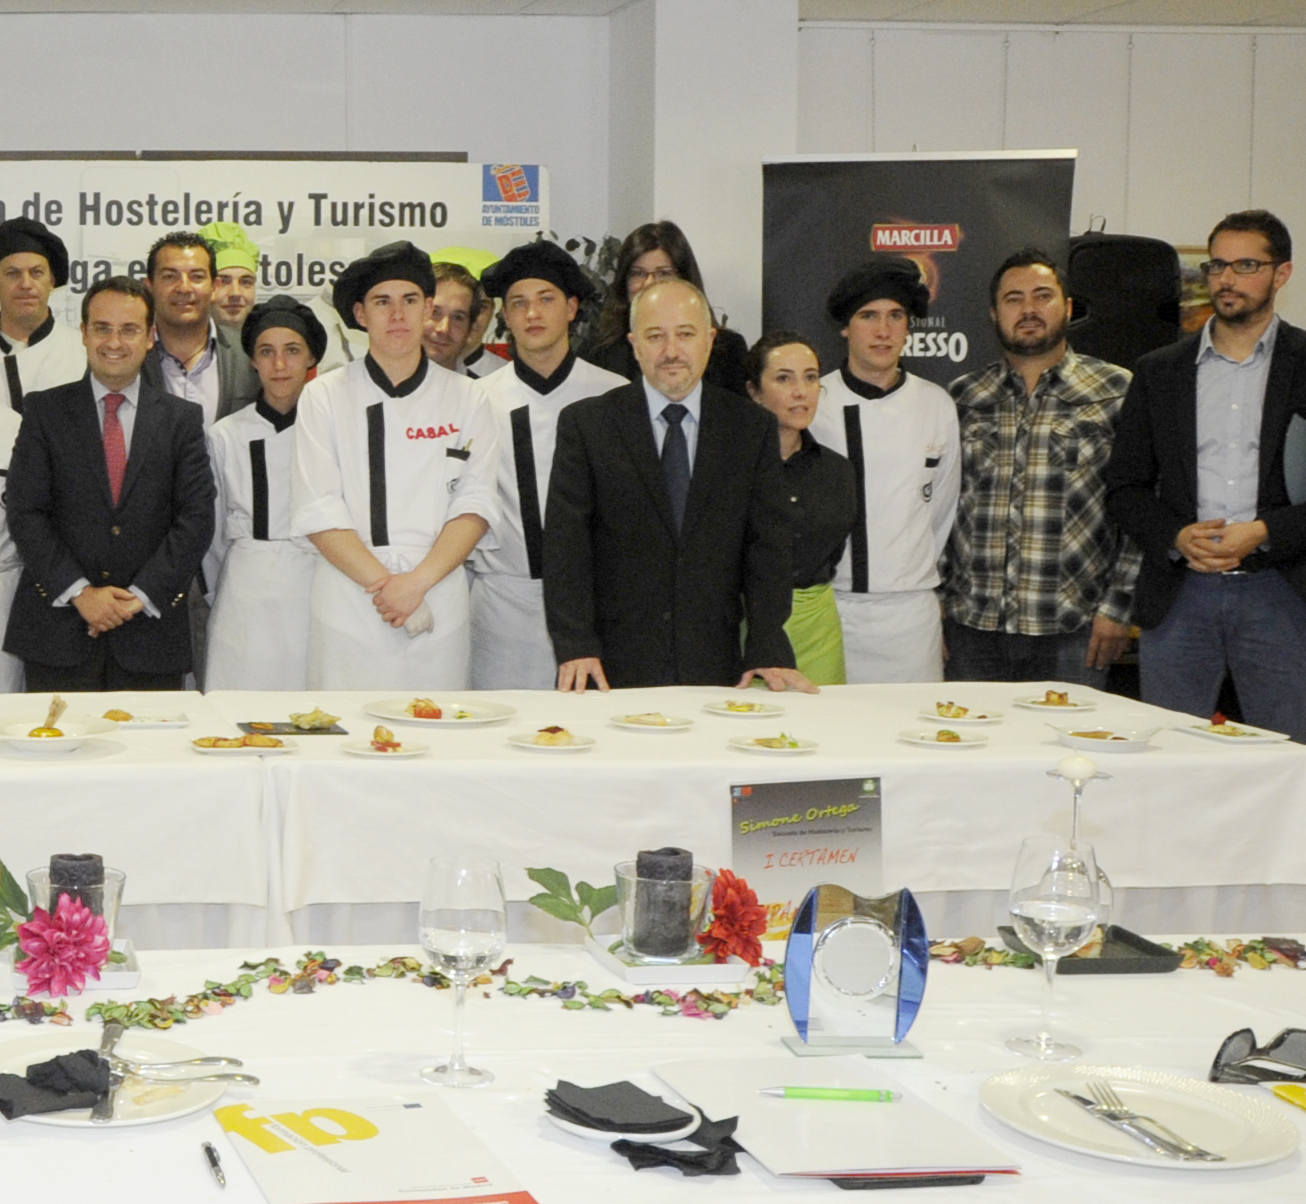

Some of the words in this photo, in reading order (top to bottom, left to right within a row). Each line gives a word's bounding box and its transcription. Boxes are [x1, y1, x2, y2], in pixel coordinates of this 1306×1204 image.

[22, 193, 63, 227] de
[79, 191, 263, 227] Hostelería
[278, 200, 295, 233] y
[308, 193, 448, 228] Turismo
[481, 204, 540, 214] AYUNTAMIENTO
[482, 216, 493, 226] DE
[876, 229, 953, 246] MARCILLA
[259, 253, 344, 288] toles
[909, 315, 945, 328] SIONAL
[899, 331, 968, 363] RESSO
[406, 423, 460, 440] CABAL
[739, 812, 803, 835] Simone
[805, 803, 861, 822] Ortega
[764, 853, 774, 869] I
[779, 847, 860, 867] CERTAMEN
[213, 1103, 379, 1154] fp
